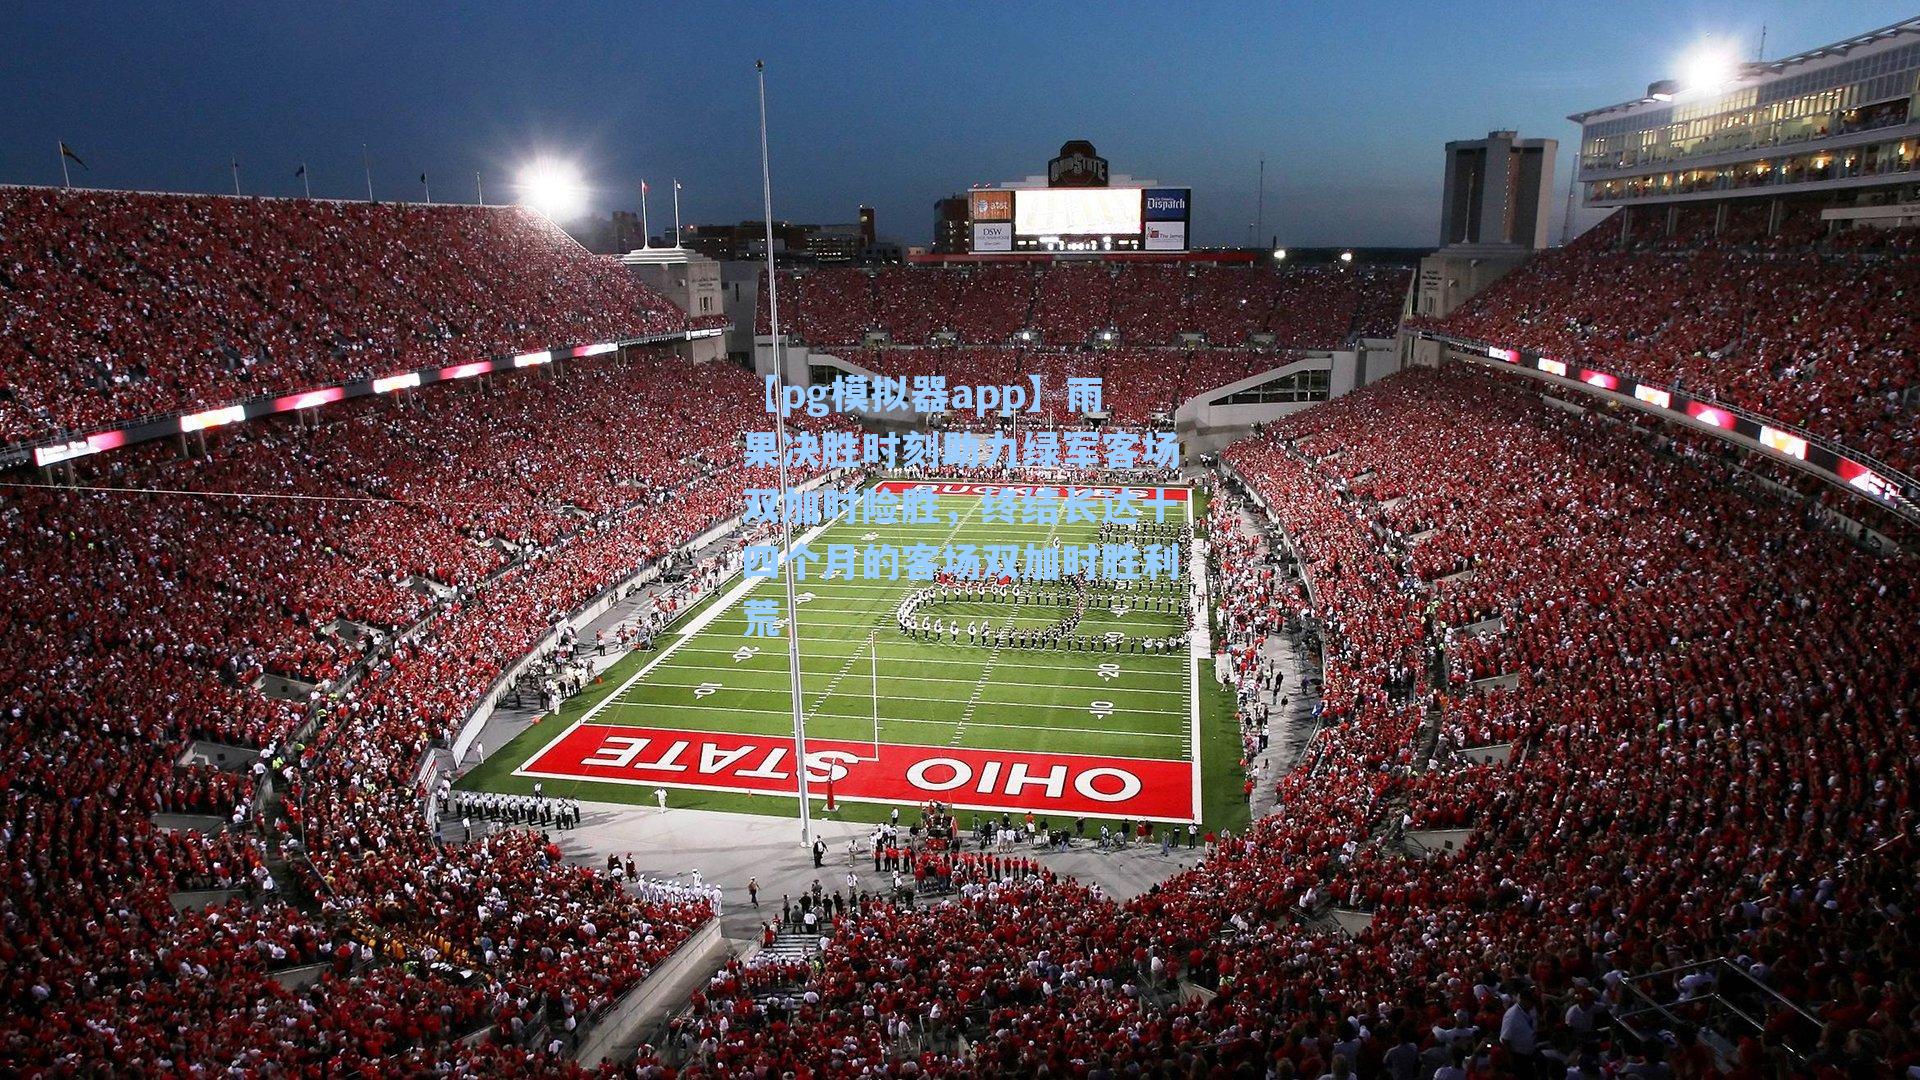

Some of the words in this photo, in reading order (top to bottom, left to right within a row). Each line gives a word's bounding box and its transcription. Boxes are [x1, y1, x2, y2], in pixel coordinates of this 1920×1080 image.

[1147, 197, 1186, 211] Dispatch
[983, 228, 1002, 236] DSW
[732, 646, 761, 659] 20
[1097, 663, 1121, 678] 20
[693, 682, 723, 696] 10
[1089, 701, 1114, 715] 10
[579, 735, 861, 784] STATE
[904, 756, 1143, 804] OHIO
